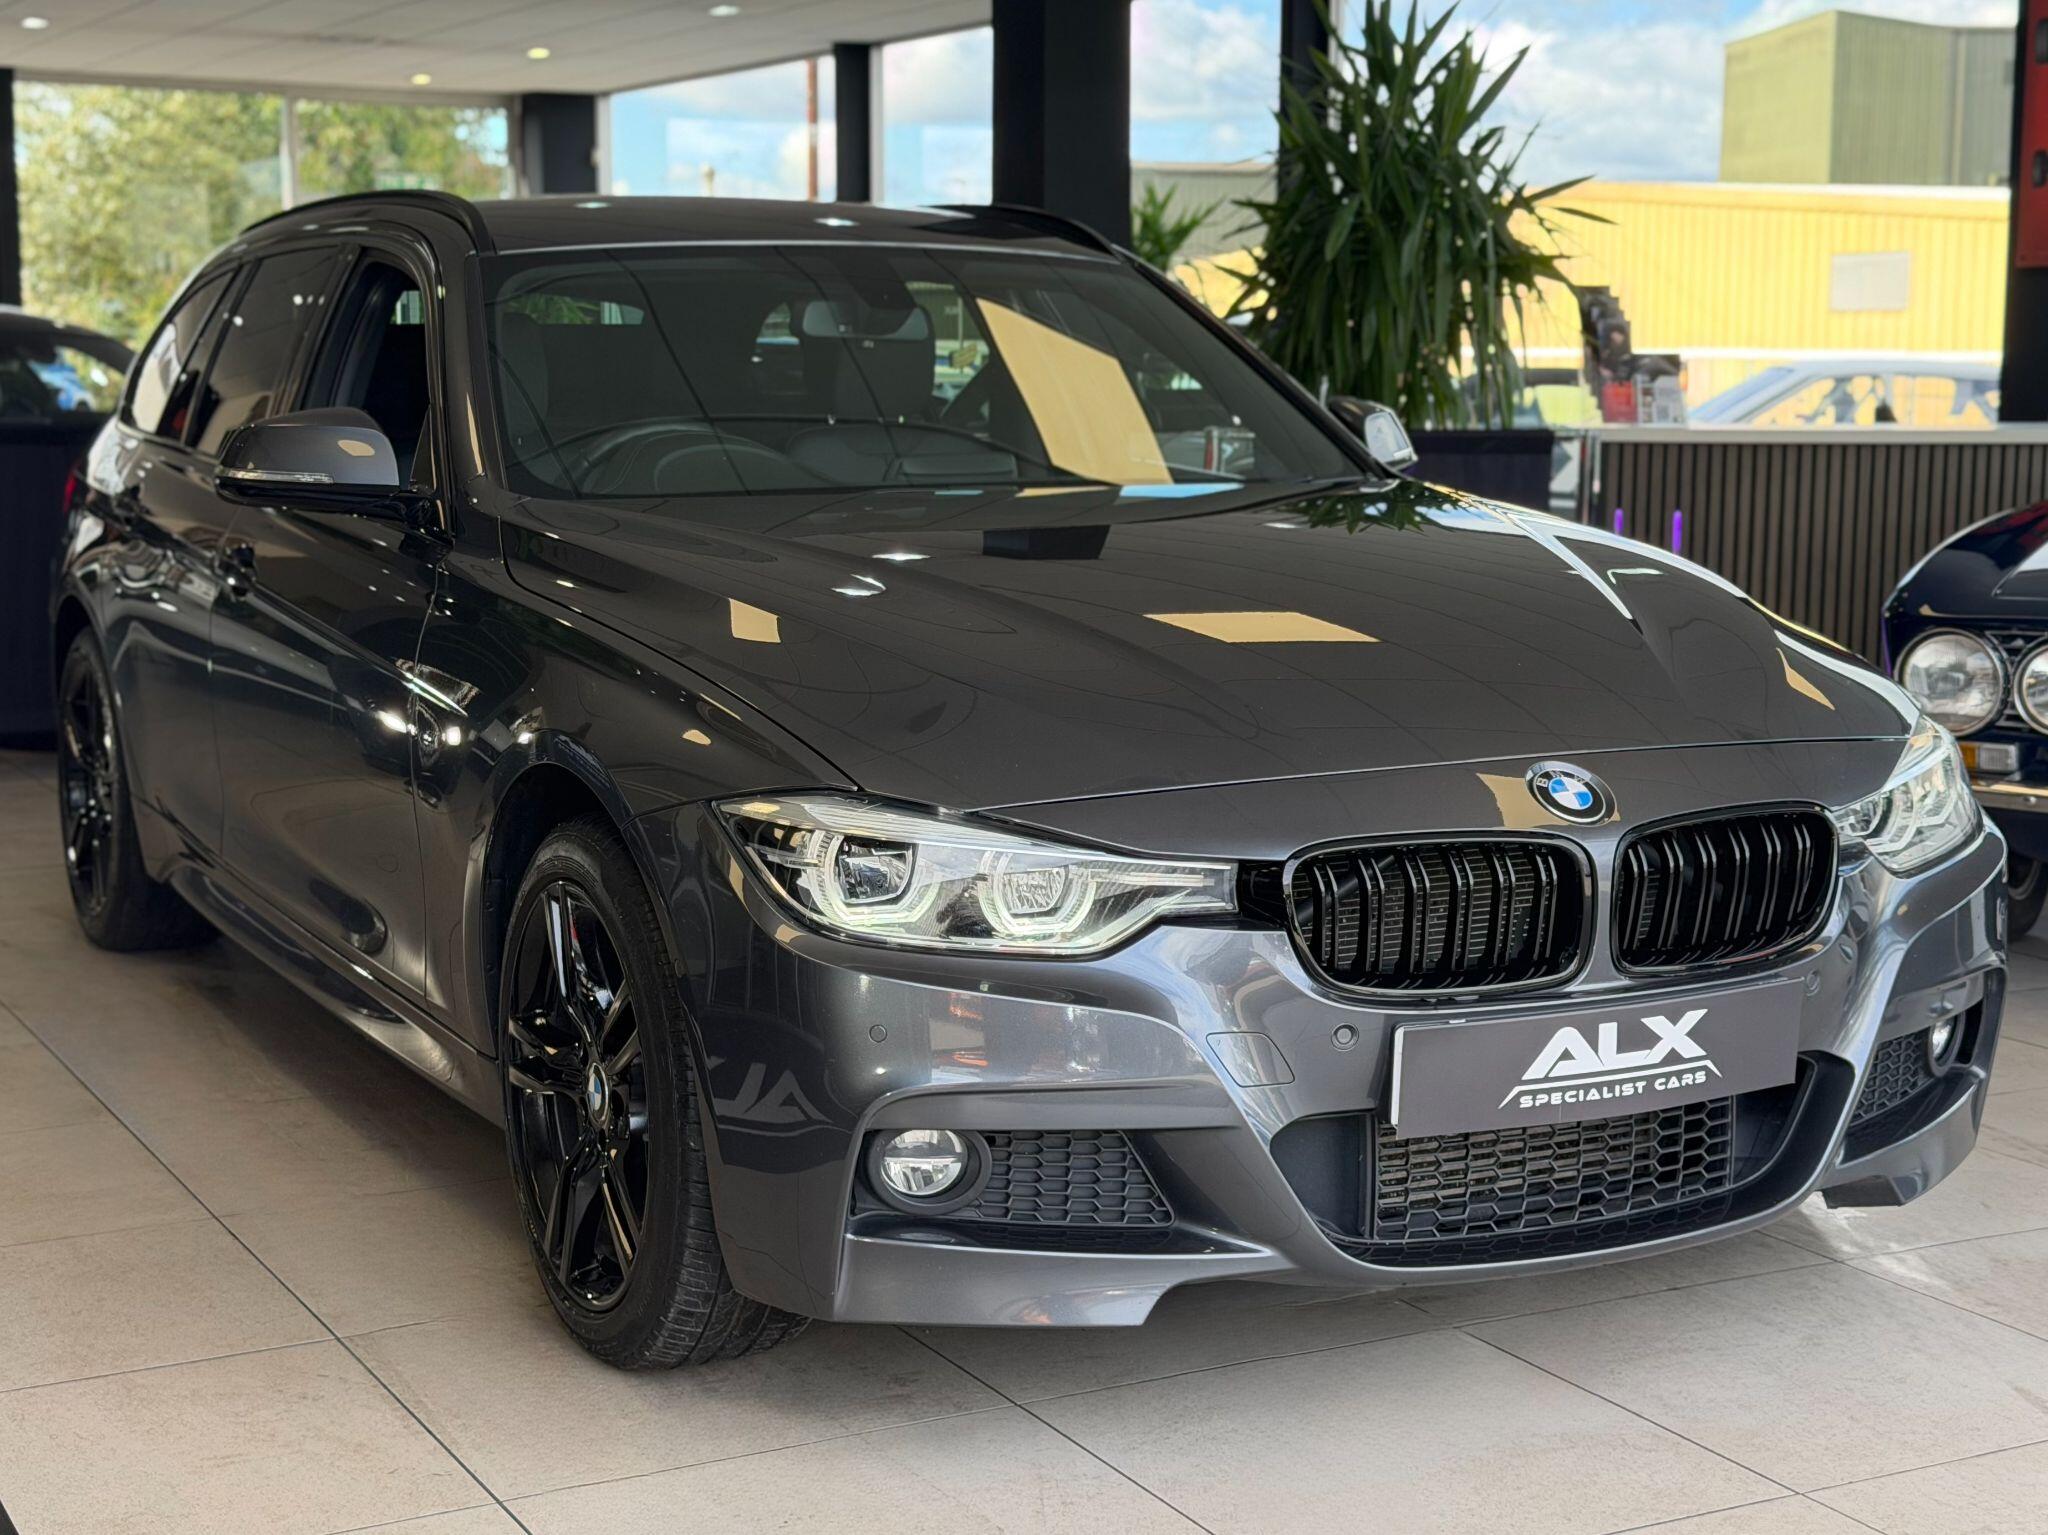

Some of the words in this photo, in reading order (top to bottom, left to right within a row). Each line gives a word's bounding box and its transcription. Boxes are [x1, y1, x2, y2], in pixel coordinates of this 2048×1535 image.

[1521, 1008, 1709, 1081] ALX
[1519, 1080, 1647, 1109] SPECIALIST
[1653, 1070, 1707, 1091] CARS
